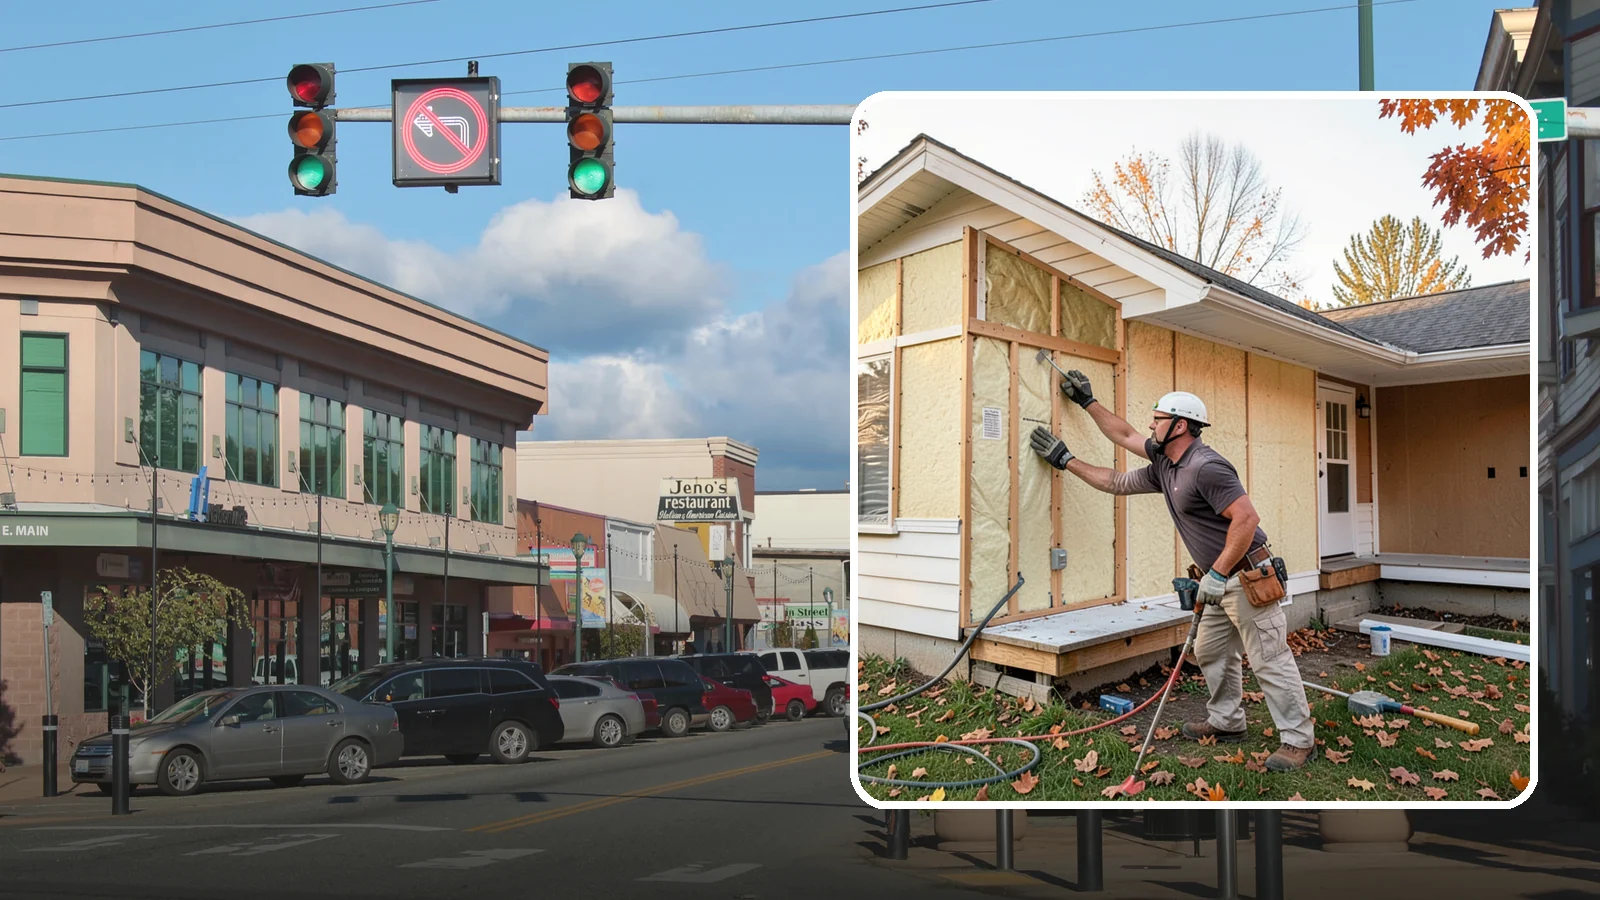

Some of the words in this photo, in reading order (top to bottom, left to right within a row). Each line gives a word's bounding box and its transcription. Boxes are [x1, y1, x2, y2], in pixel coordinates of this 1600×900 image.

[670, 480, 727, 494] Jeno's
[665, 496, 731, 509] restaurant
[659, 510, 682, 519] Italian
[686, 510, 714, 519] American
[714, 509, 737, 519] Cuisine
[2, 525, 13, 536] E.
[15, 525, 49, 536] MAIN
[797, 607, 828, 617] Street
